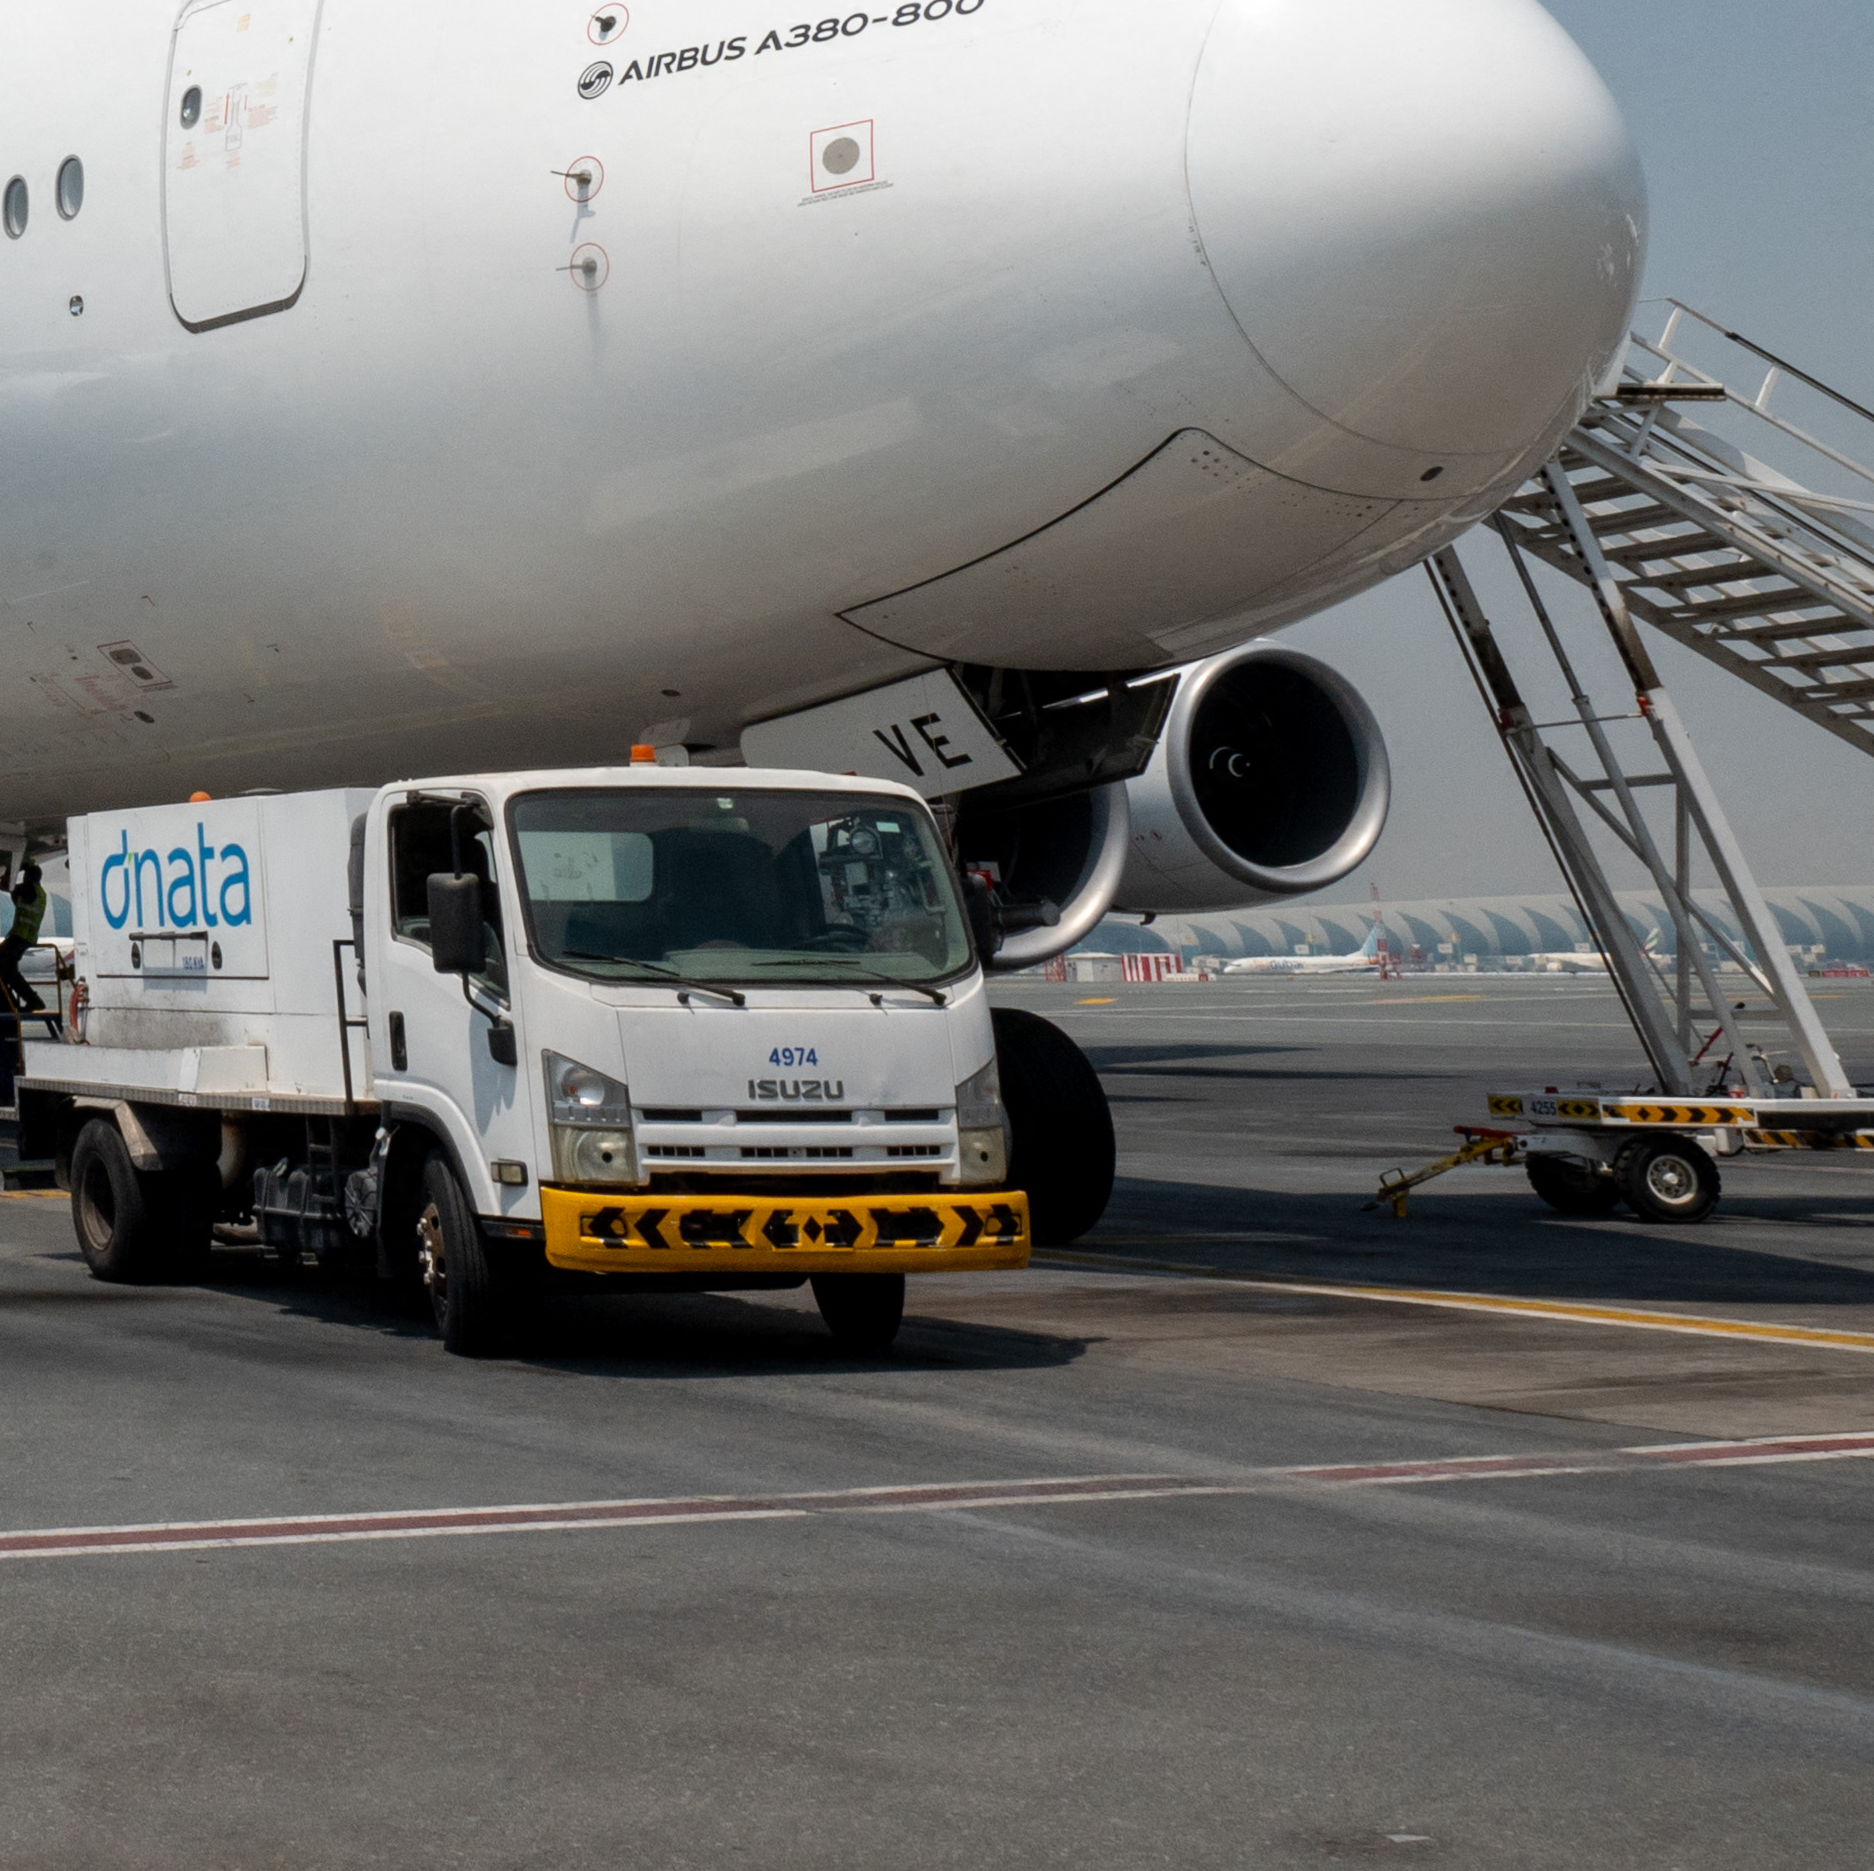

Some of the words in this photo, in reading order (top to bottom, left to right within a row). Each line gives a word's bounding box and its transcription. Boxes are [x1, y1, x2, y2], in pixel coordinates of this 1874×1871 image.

[618, 36, 748, 86] AIRBUS
[873, 712, 974, 778] VE
[101, 821, 252, 930] dnata
[768, 1046, 819, 1067] 4974
[747, 1078, 844, 1100] ISUZU
[1530, 1099, 1558, 1117] 4255
